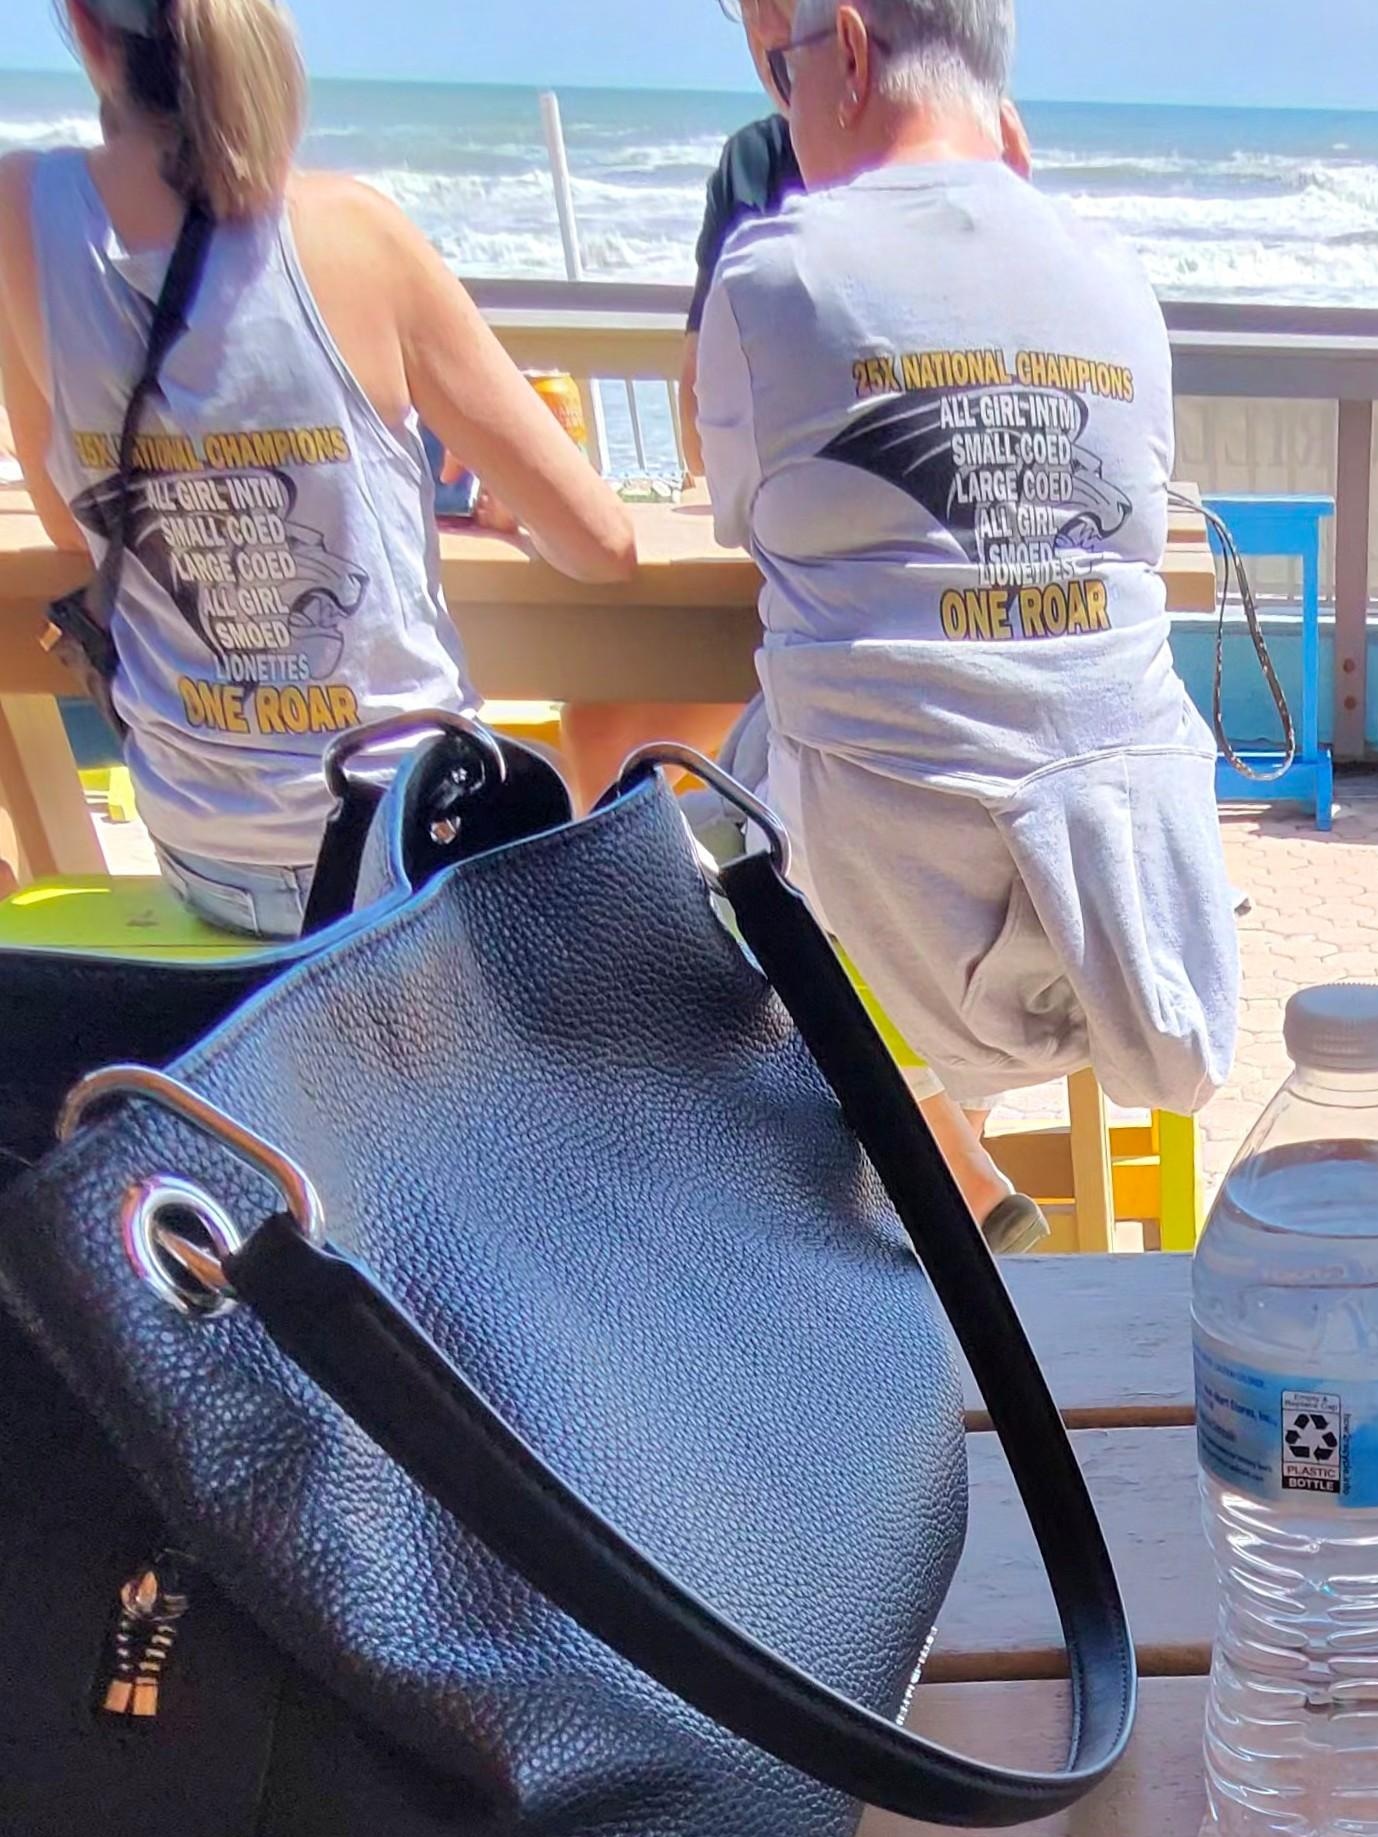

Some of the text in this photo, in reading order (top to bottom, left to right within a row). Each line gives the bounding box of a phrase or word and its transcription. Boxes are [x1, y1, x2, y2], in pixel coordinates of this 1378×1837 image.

[853, 350, 1135, 403] 25X NATIONAL CHAMPIONS
[940, 394, 1076, 431] ALL GIRL INTM
[204, 427, 350, 471] CHAMPIONS
[952, 432, 1071, 466] SMALL COED
[146, 475, 284, 512] ALL GIRL INTM
[956, 471, 1073, 503] LARGE COED
[159, 513, 287, 549] SMALL COED
[980, 505, 1058, 538] ALL GIRL
[170, 549, 298, 583] LARGE COED
[989, 543, 1053, 564] SMOED
[202, 586, 290, 618] ALL GIRL
[940, 578, 1112, 641] ONE ROAR
[215, 621, 291, 650] SMOED
[213, 653, 311, 682] LIONETTES
[178, 676, 361, 735] ONE ROAR
[1286, 1465, 1337, 1478] PLASTIC
[1289, 1477, 1335, 1491] BOTTLE
